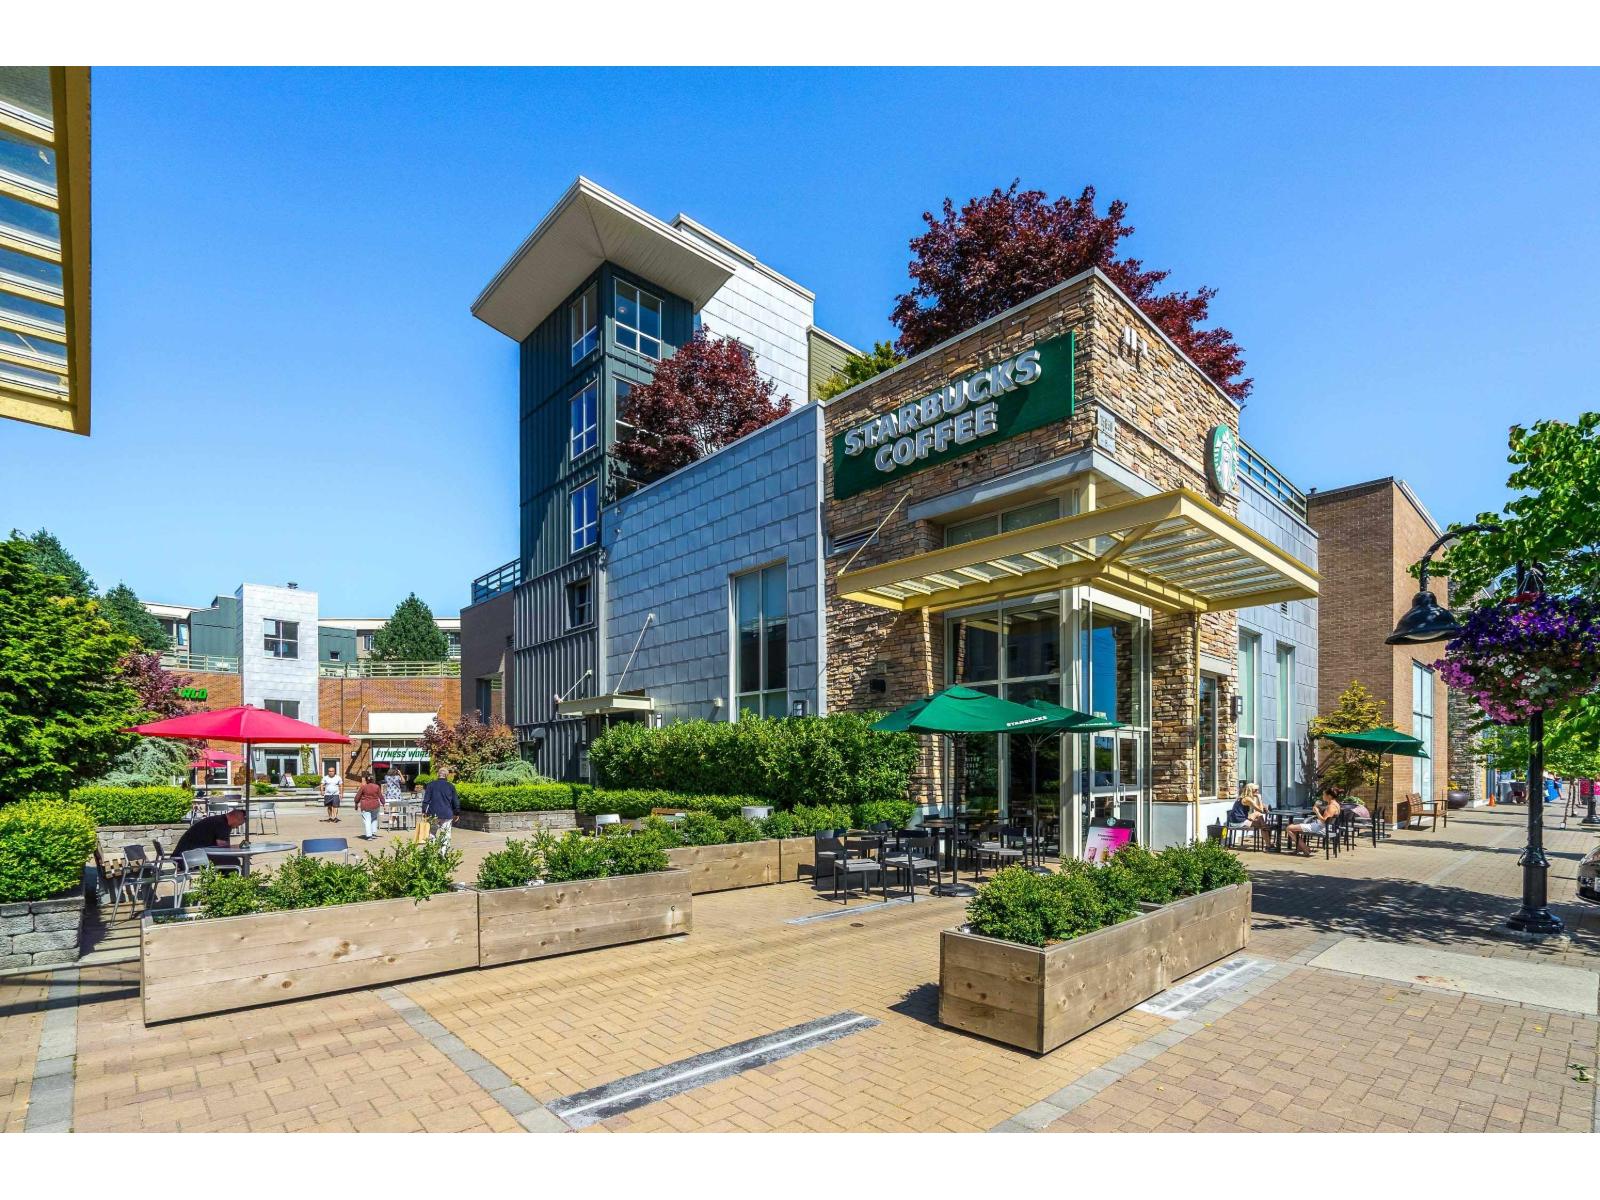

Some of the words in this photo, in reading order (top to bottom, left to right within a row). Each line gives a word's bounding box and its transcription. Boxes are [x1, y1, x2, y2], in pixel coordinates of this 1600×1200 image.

[844, 350, 1042, 457] STARBUCKS
[874, 401, 999, 472] COFFEE
[376, 750, 406, 758] FITNESS
